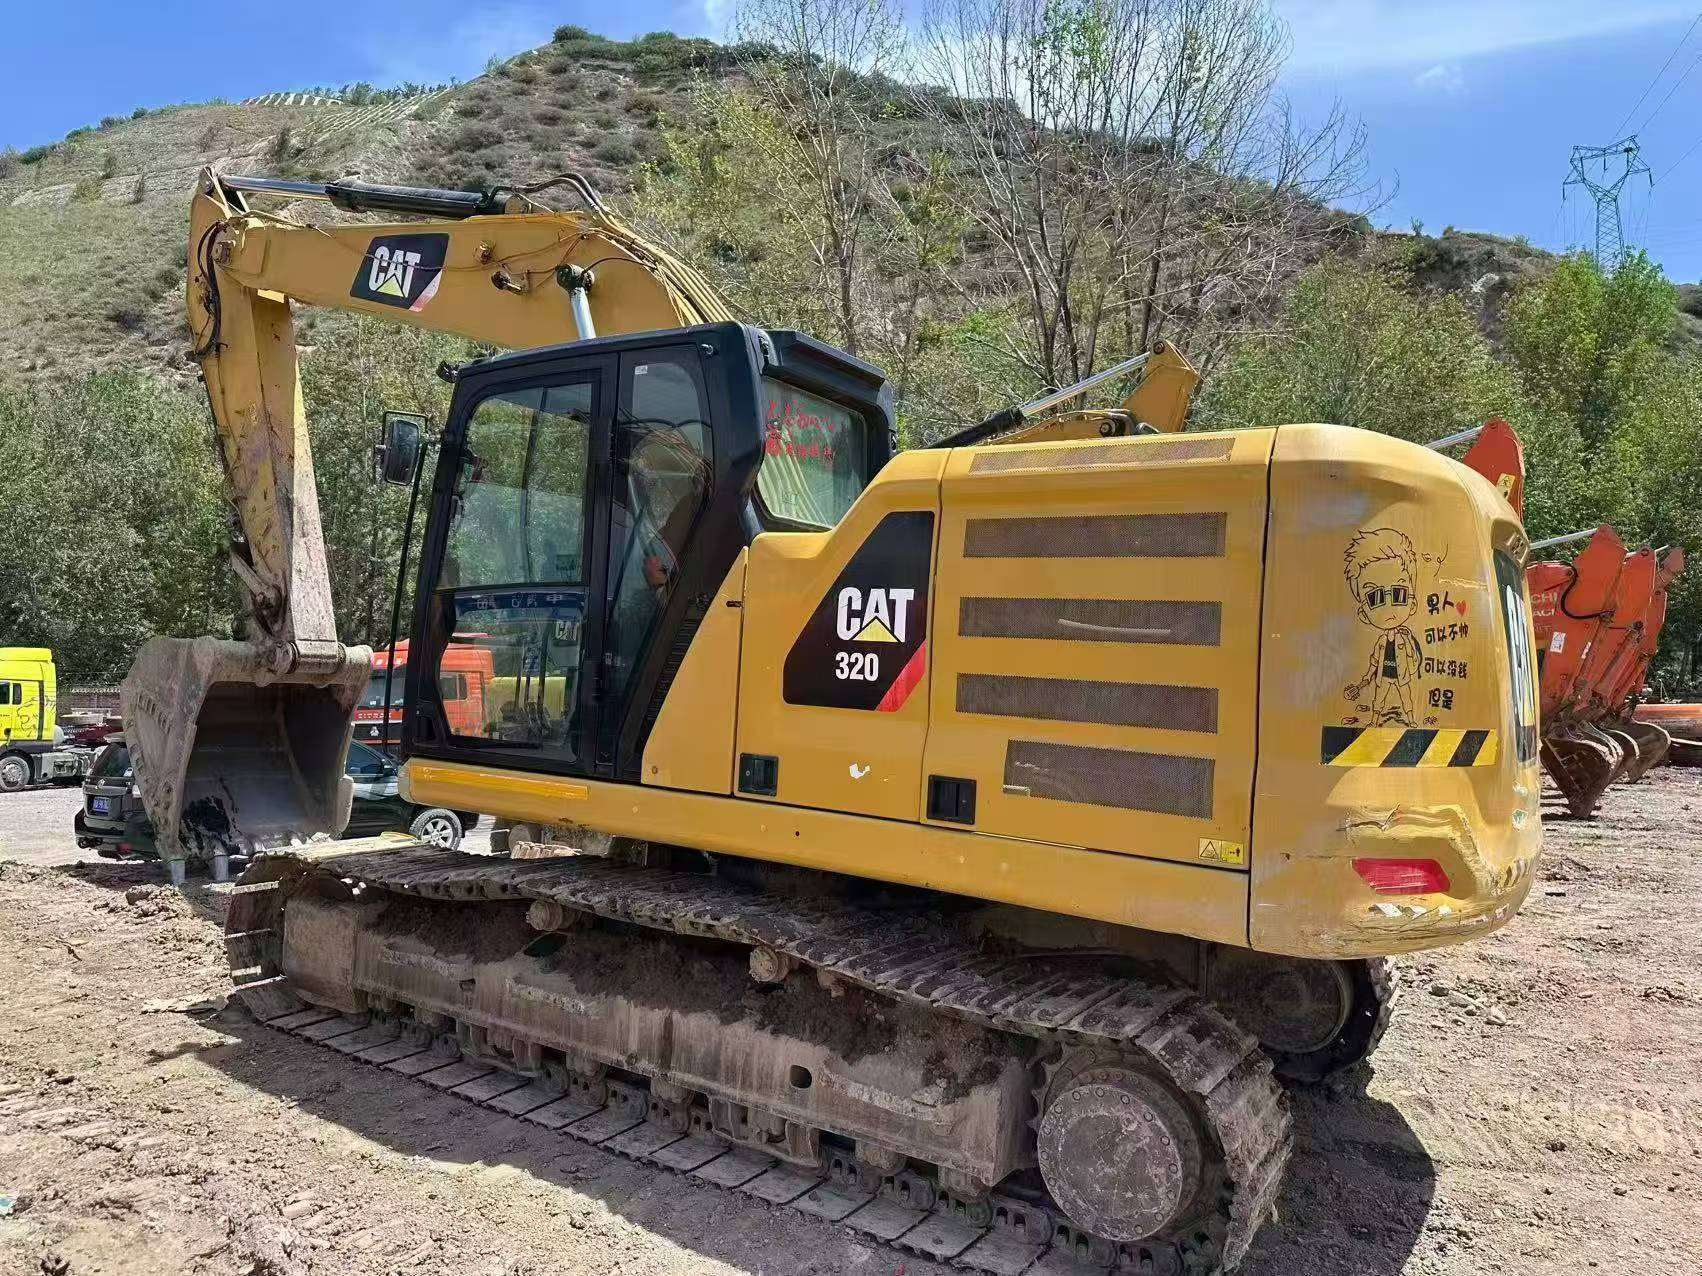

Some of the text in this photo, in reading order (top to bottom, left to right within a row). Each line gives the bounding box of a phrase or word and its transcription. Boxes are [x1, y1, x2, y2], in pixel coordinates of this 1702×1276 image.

[369, 246, 421, 298] CAT
[837, 587, 914, 642] CAT
[1426, 591, 1454, 615] 男人
[1425, 622, 1469, 645] 可以不帅
[835, 652, 879, 681] 320
[1424, 657, 1468, 680] 可以没钱
[1428, 688, 1454, 710] 但是
